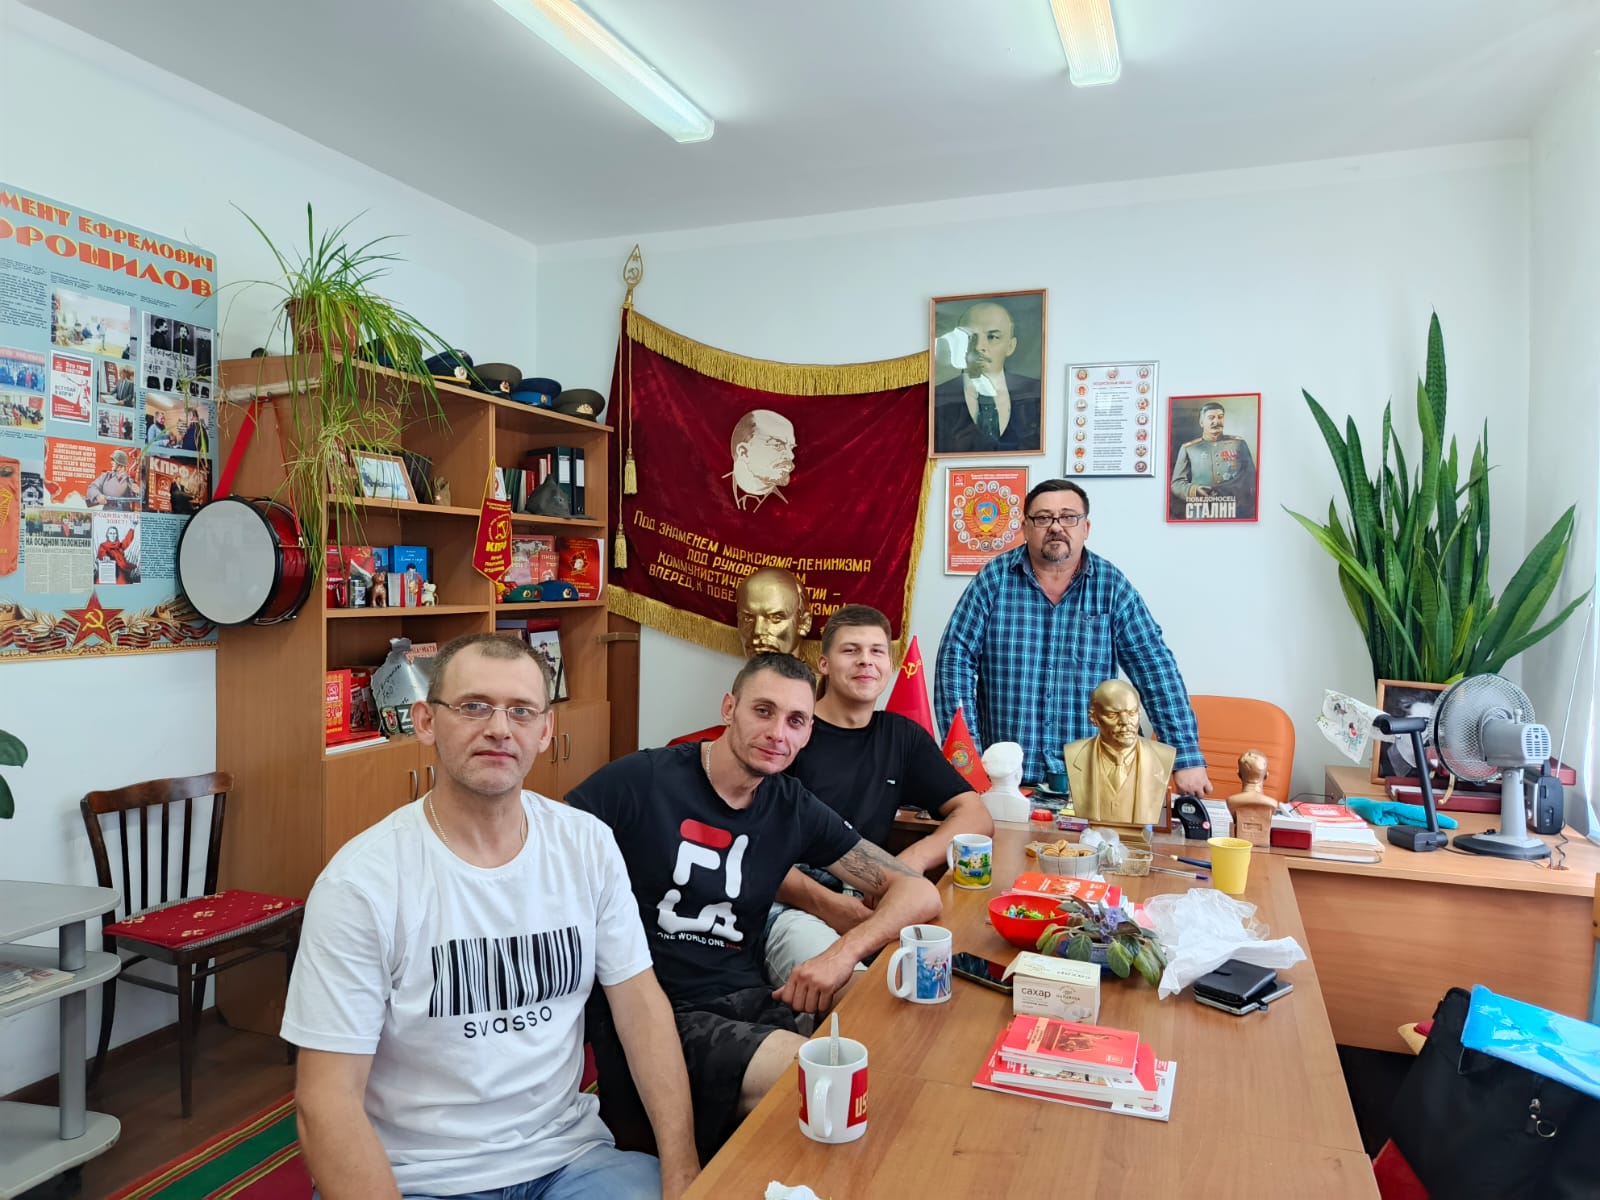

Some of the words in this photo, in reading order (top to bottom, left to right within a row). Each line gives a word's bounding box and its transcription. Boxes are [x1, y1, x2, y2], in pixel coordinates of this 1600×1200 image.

[78, 215, 214, 273] ЕФРЕМОВИЧ
[1185, 502, 1236, 519] СТАЛИН
[658, 522, 719, 553] ЗНАМЕНЕМ
[722, 544, 871, 573] МАРКСИЗМА-ЛЕНИНИЗМА
[686, 549, 708, 565] ПОД
[678, 932, 707, 944] WORLD
[708, 939, 725, 948] ONE
[1021, 986, 1051, 999] сахар
[464, 1006, 552, 1039] svasso
